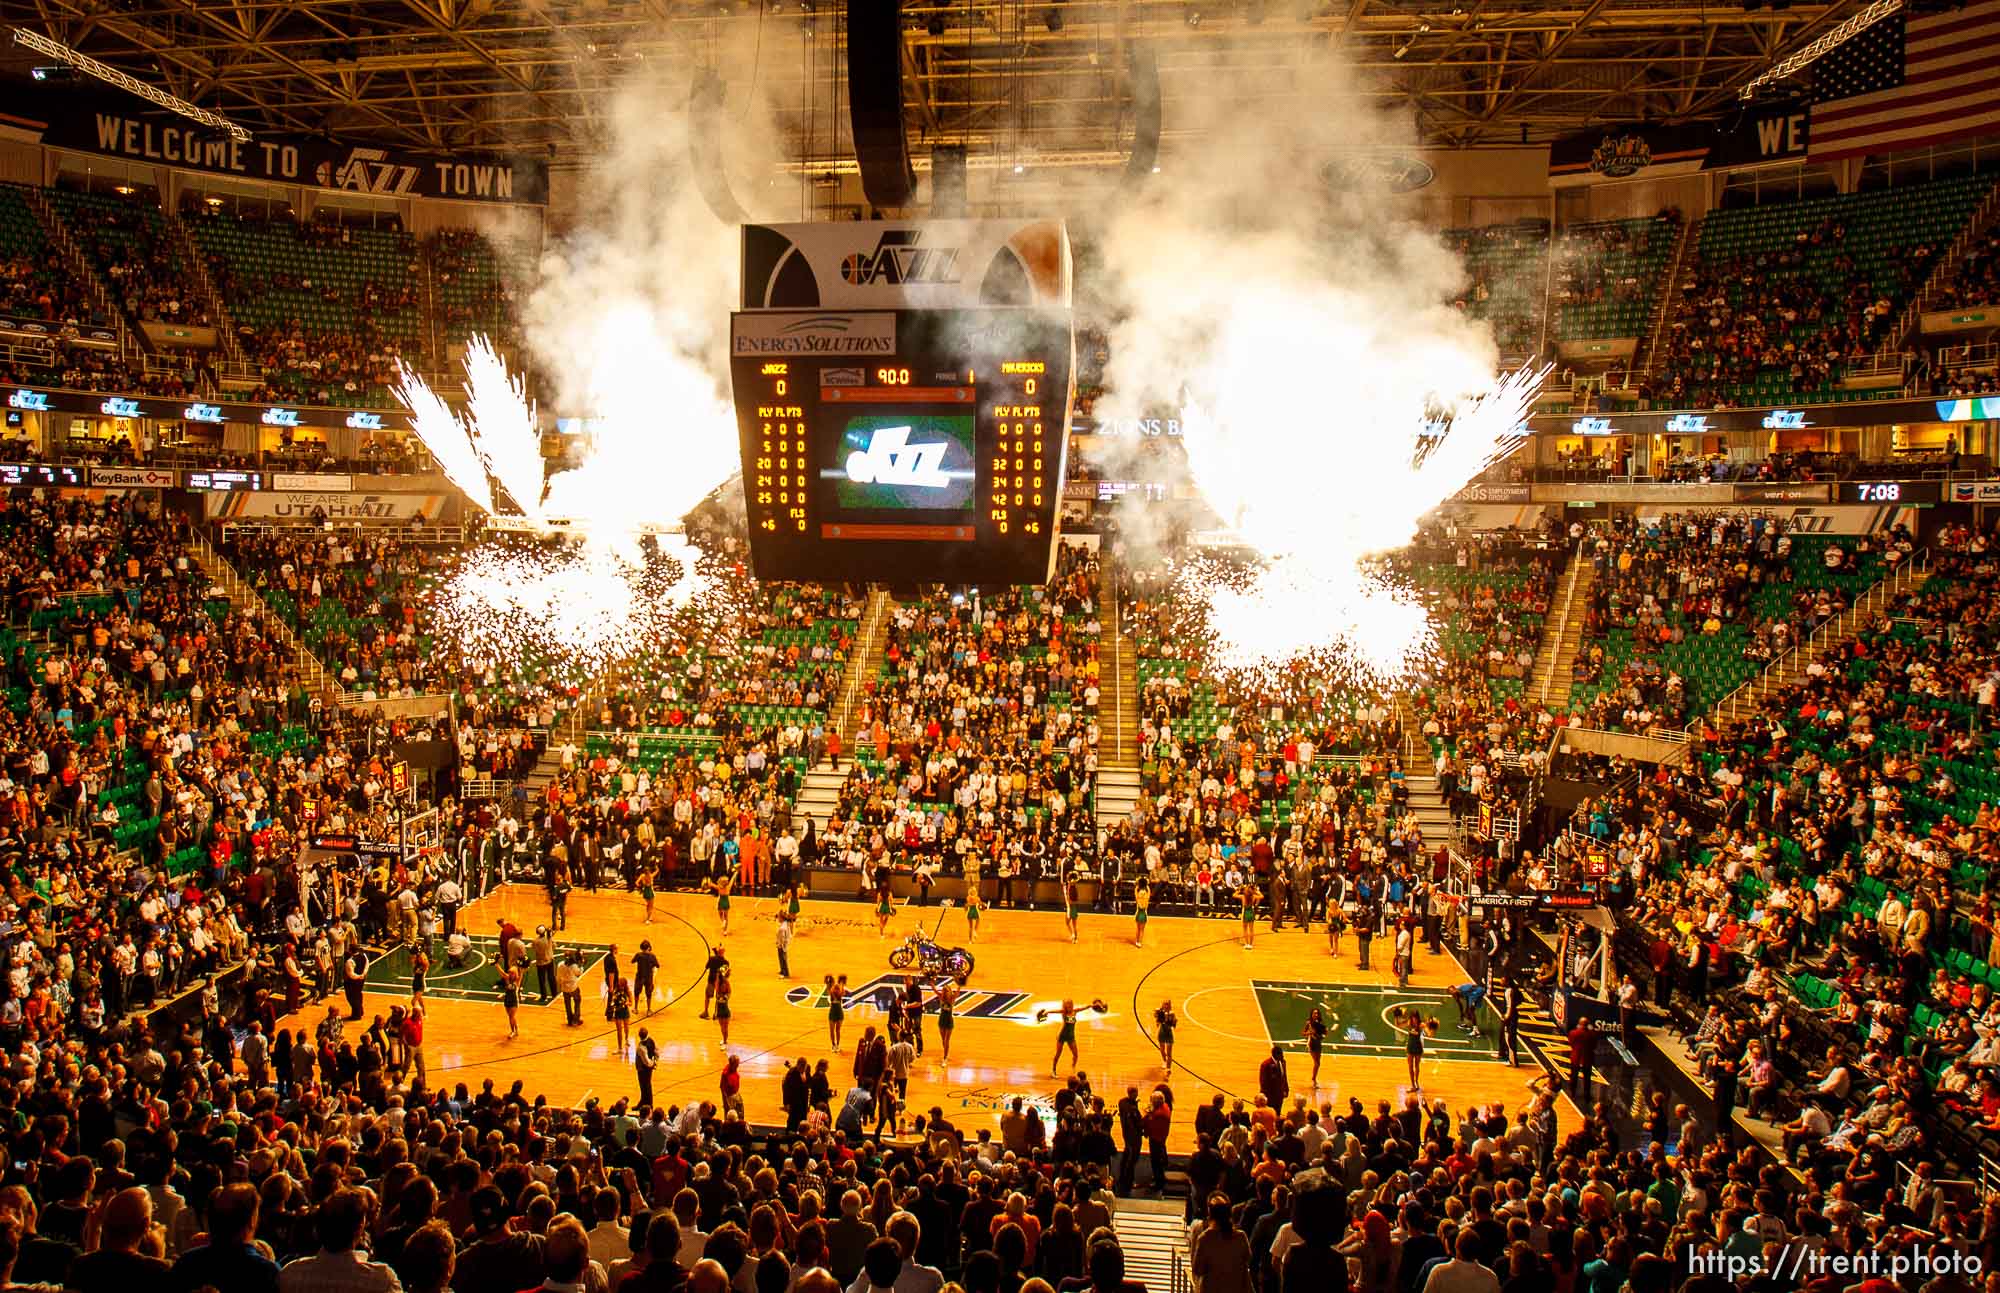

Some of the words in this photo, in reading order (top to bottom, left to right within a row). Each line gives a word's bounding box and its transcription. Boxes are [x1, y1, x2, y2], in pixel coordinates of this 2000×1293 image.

[1758, 114, 1806, 155] WE
[96, 113, 247, 171] WELCOME
[260, 141, 299, 178] TO
[435, 163, 513, 198] TOWN
[841, 230, 961, 285] JAZZ
[761, 364, 788, 375] JAZZ
[878, 368, 909, 385] 90.0
[776, 380, 786, 395] 0
[1025, 378, 1036, 394] 0
[763, 423, 772, 435] 2
[780, 423, 788, 435] 0
[797, 423, 805, 435] 0
[1000, 423, 1008, 435] 0
[1015, 423, 1024, 435] 0
[1034, 423, 1042, 435] 0
[763, 441, 772, 453] 5
[780, 441, 788, 453] 0
[797, 441, 805, 453] 0
[1000, 441, 1008, 453] 4
[1015, 441, 1024, 453] 0
[1034, 441, 1042, 453] 0
[757, 458, 772, 470] 20
[780, 458, 788, 470] 0
[797, 458, 806, 470] 0
[992, 459, 1007, 471] 32
[1015, 459, 1023, 471] 0
[1034, 459, 1042, 471] 0
[93, 472, 144, 485] KeyBank
[757, 475, 772, 487] 24
[780, 475, 788, 487] 0
[797, 475, 806, 487] 0
[992, 477, 1007, 489] 34
[1015, 477, 1023, 489] 0
[1034, 477, 1042, 489] 0
[757, 492, 772, 504] 25
[780, 492, 788, 504] 0
[797, 492, 806, 504] 0
[1462, 488, 1487, 501] SOS
[1858, 484, 1900, 500] 7:08
[287, 494, 312, 503] WE
[318, 495, 350, 504] ARE
[992, 494, 1007, 506] 42
[1015, 494, 1023, 506] 0
[1034, 494, 1042, 506] 0
[275, 504, 345, 516] UTAH
[798, 519, 806, 531] 0
[1000, 522, 1008, 533] 0
[1592, 864, 1604, 872] 24
[1472, 897, 1508, 905] AMERICA
[1510, 898, 1533, 906] FIRST
[1594, 1020, 1624, 1032] State
